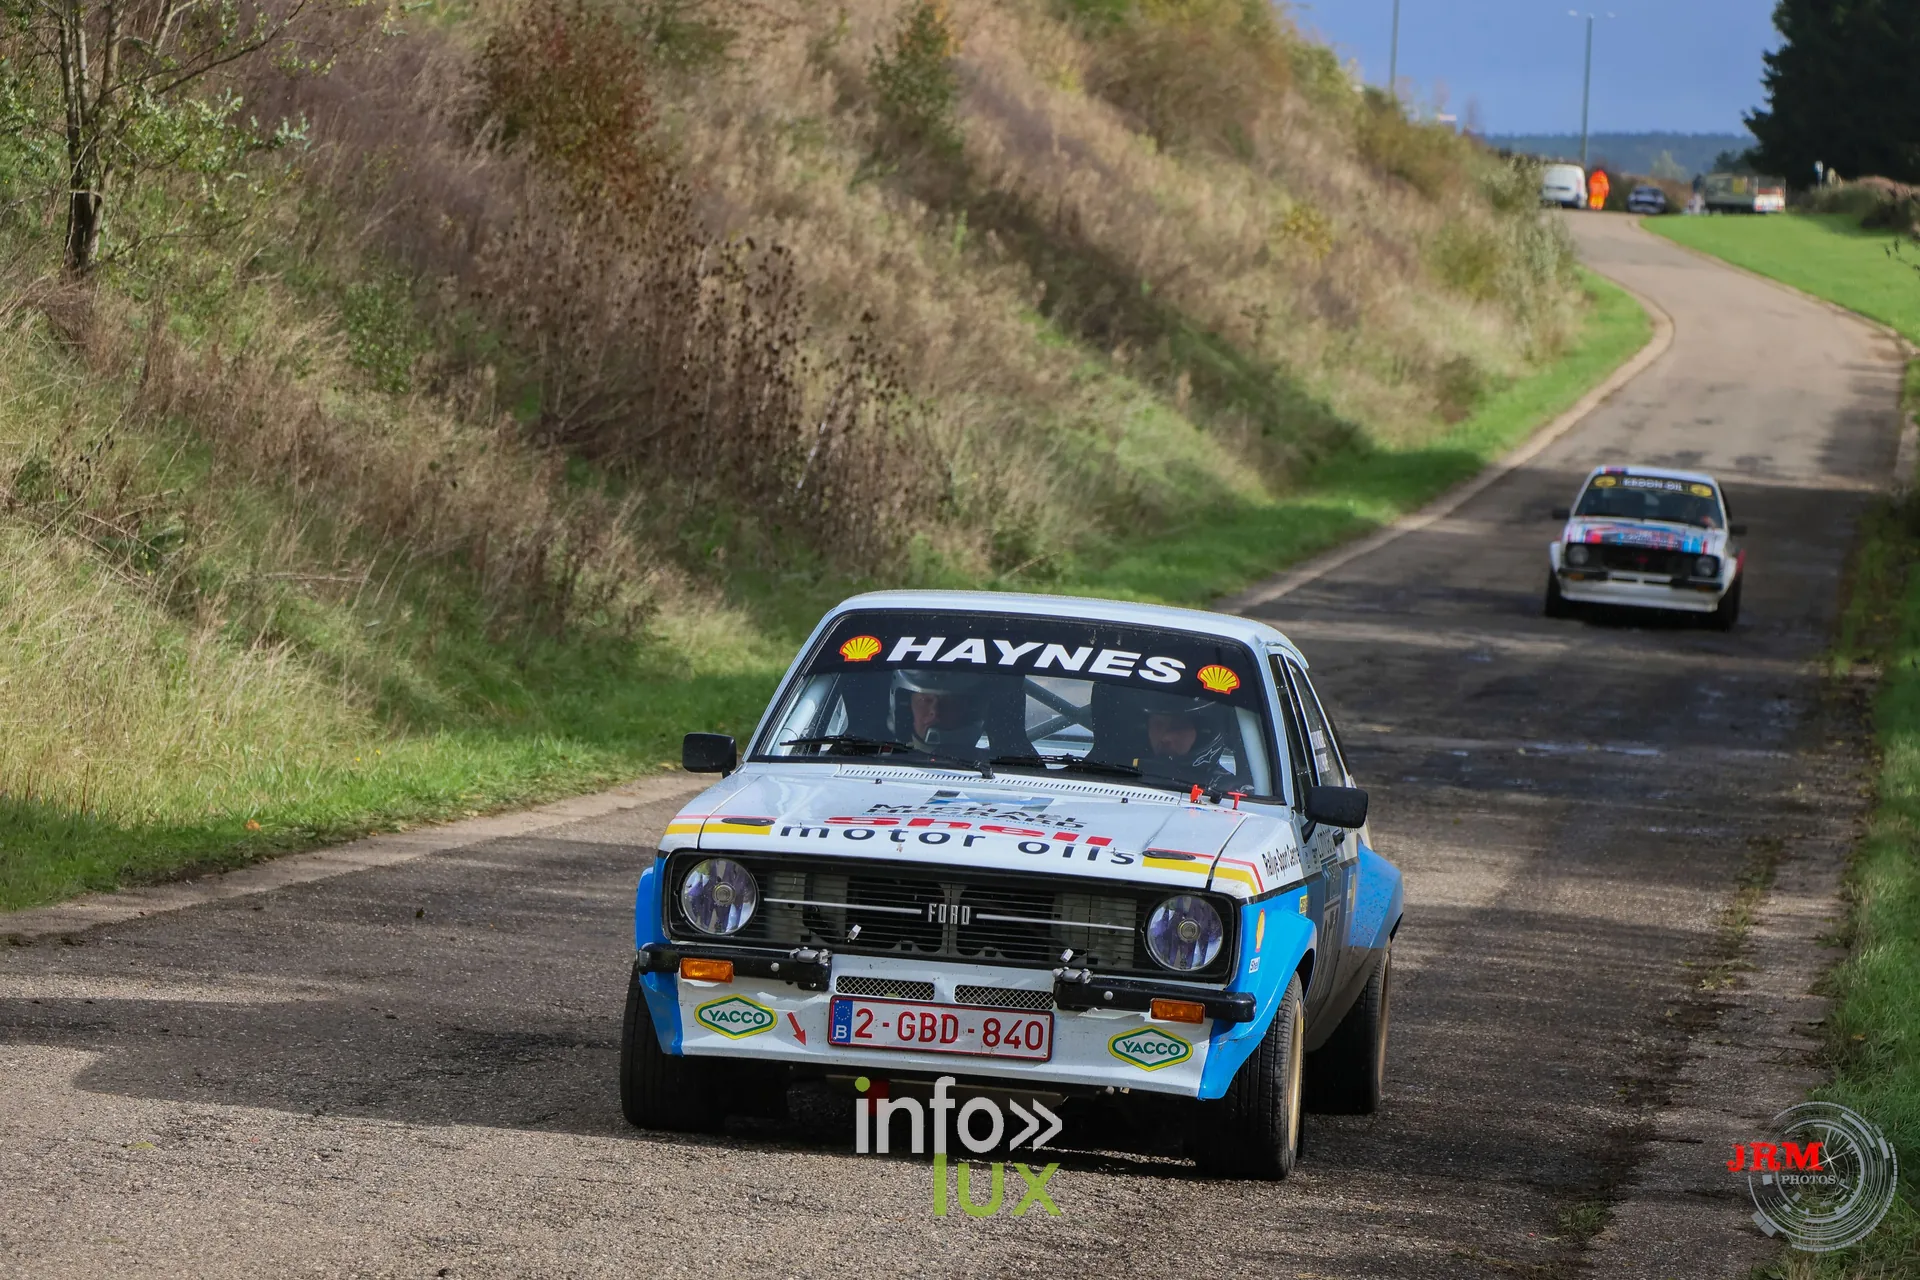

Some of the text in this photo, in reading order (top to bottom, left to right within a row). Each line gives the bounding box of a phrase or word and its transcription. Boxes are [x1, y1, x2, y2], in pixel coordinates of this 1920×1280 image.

[886, 635, 1186, 685] HAYNES
[780, 825, 1135, 865] motor oils
[927, 903, 971, 925] FORD
[708, 1009, 766, 1025] YACCO
[835, 1008, 1044, 1051] B 2-GBD-840
[1122, 1041, 1181, 1056] YACCO
